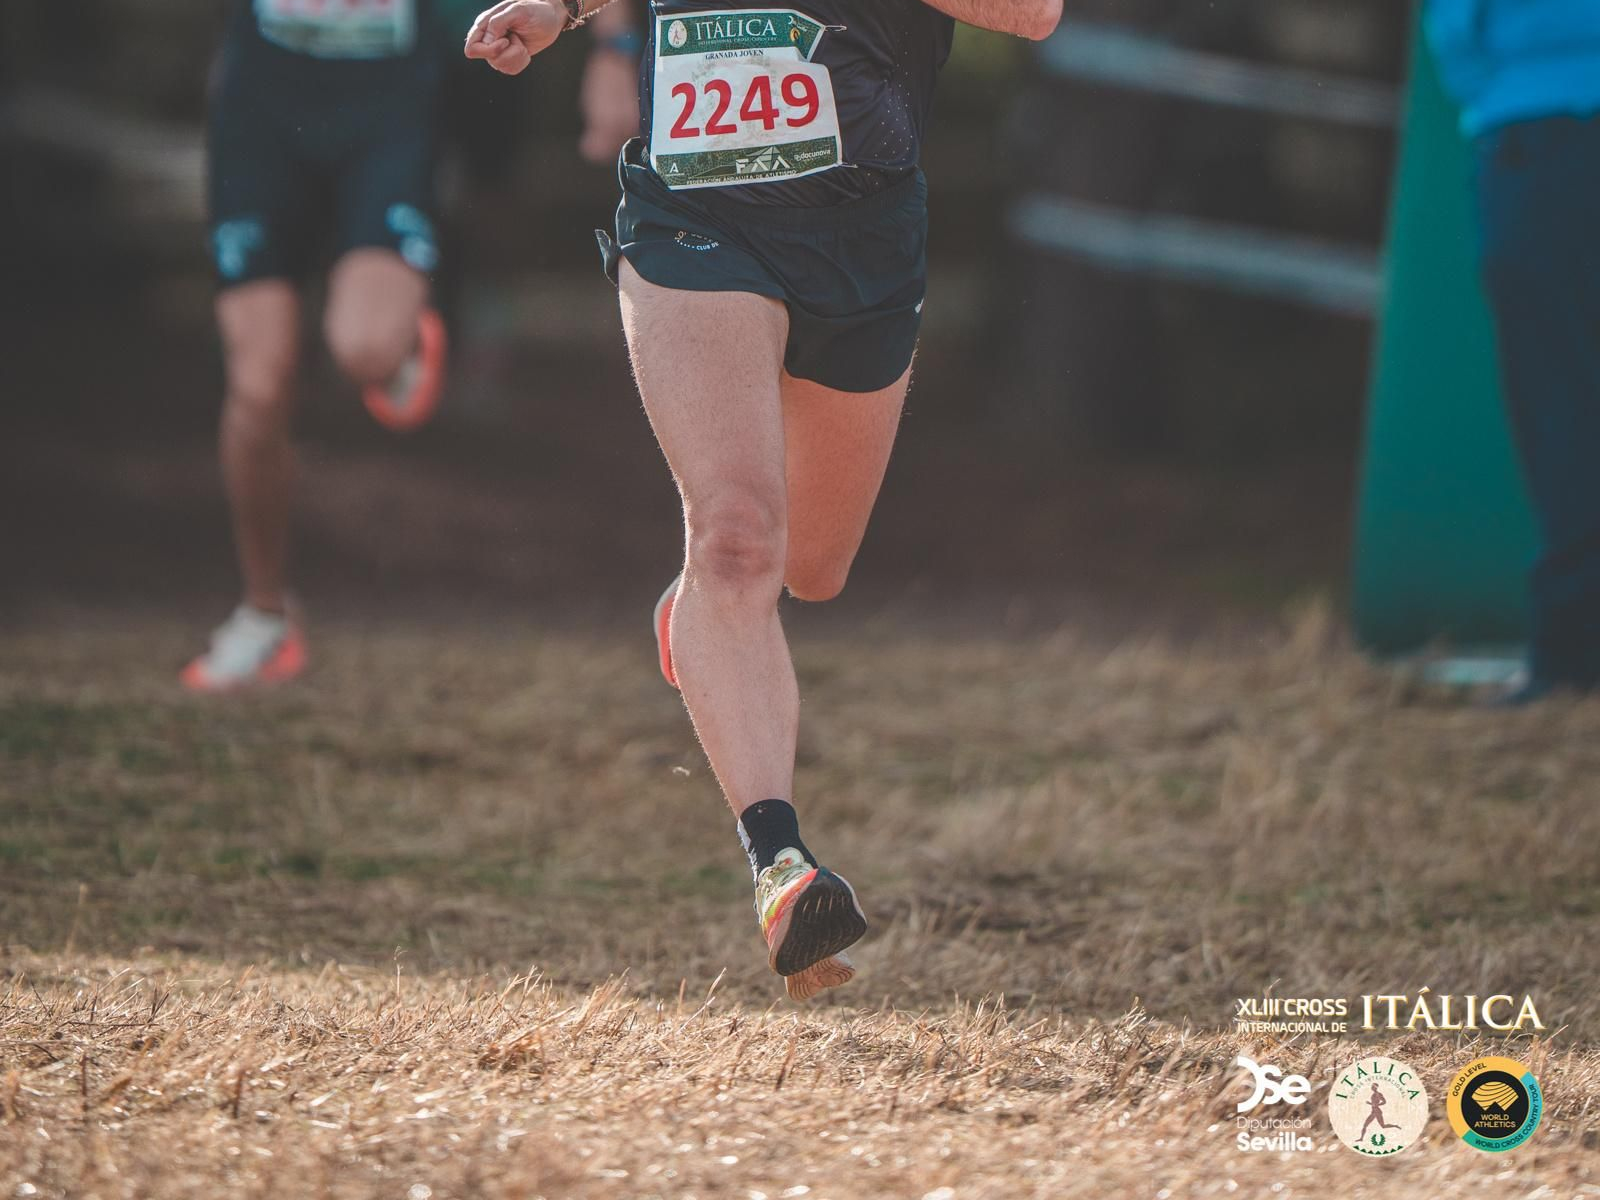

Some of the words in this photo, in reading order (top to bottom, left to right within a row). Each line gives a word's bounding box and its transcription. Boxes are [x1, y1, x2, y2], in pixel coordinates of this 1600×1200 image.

[695, 16, 777, 40] ITÁLICA
[705, 51, 738, 60] GRANADA
[740, 49, 764, 57] JOVEN
[670, 73, 820, 139] 2249
[800, 149, 831, 160] docunova
